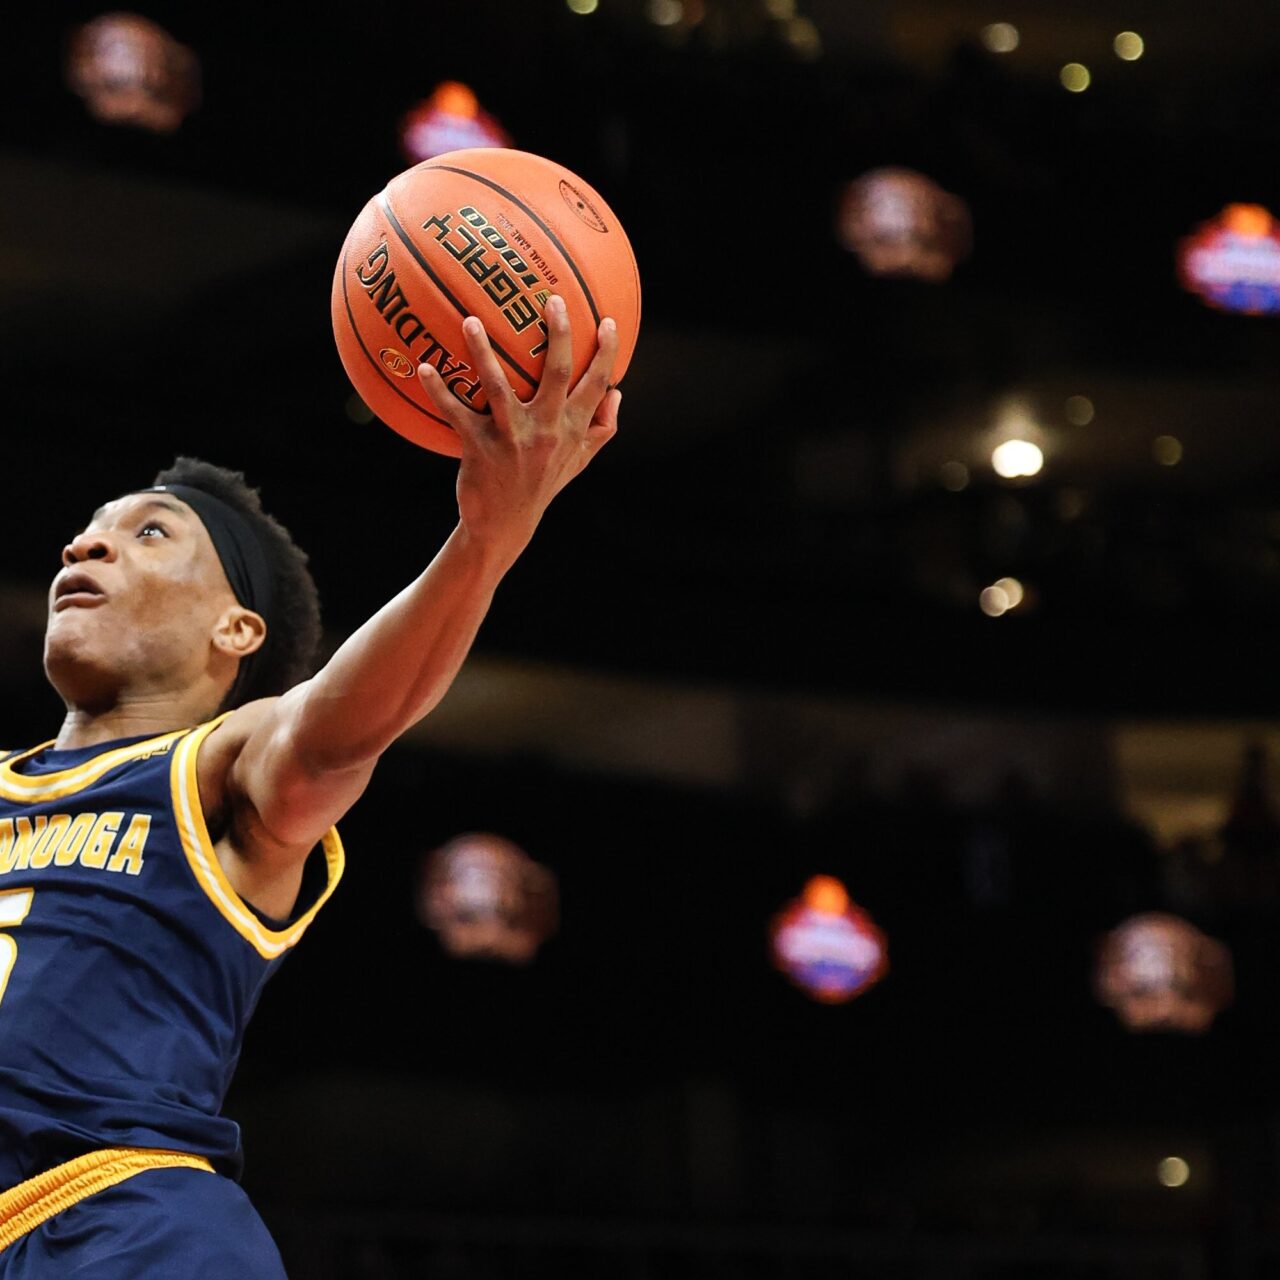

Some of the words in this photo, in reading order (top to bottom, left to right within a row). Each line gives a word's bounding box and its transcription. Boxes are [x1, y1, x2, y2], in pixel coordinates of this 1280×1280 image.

[458, 205, 540, 290] 1000
[511, 229, 531, 251] GAME
[529, 250, 559, 286] OFFICIAL
[422, 213, 549, 357] LEGACY
[356, 242, 493, 415] PALDING
